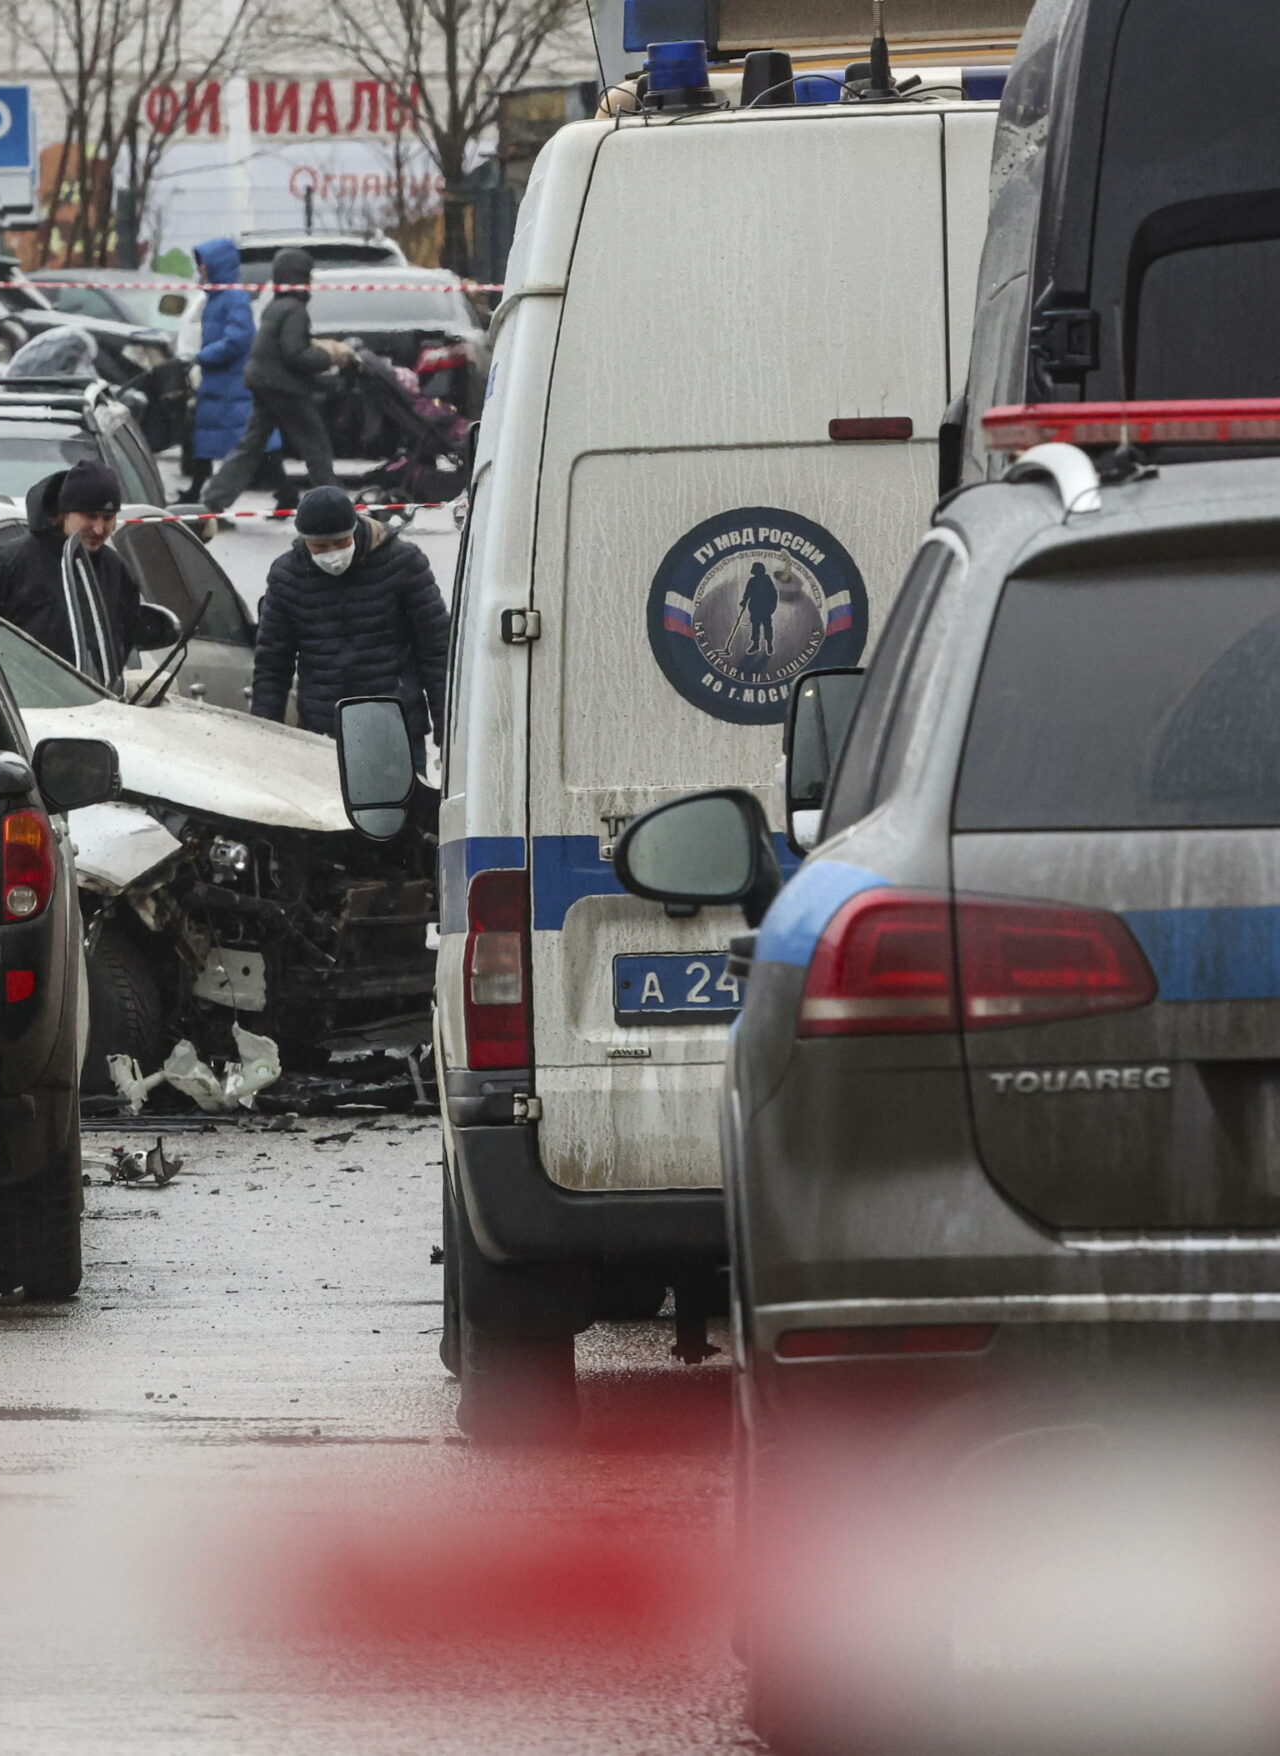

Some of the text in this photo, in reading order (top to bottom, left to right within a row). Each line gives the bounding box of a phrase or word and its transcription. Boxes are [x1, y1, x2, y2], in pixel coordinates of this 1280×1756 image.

[693, 527, 826, 566] ГУ МВД РОССИИ
[728, 684, 790, 704] г.МОСК
[989, 1066, 1170, 1093] TOUAREG
